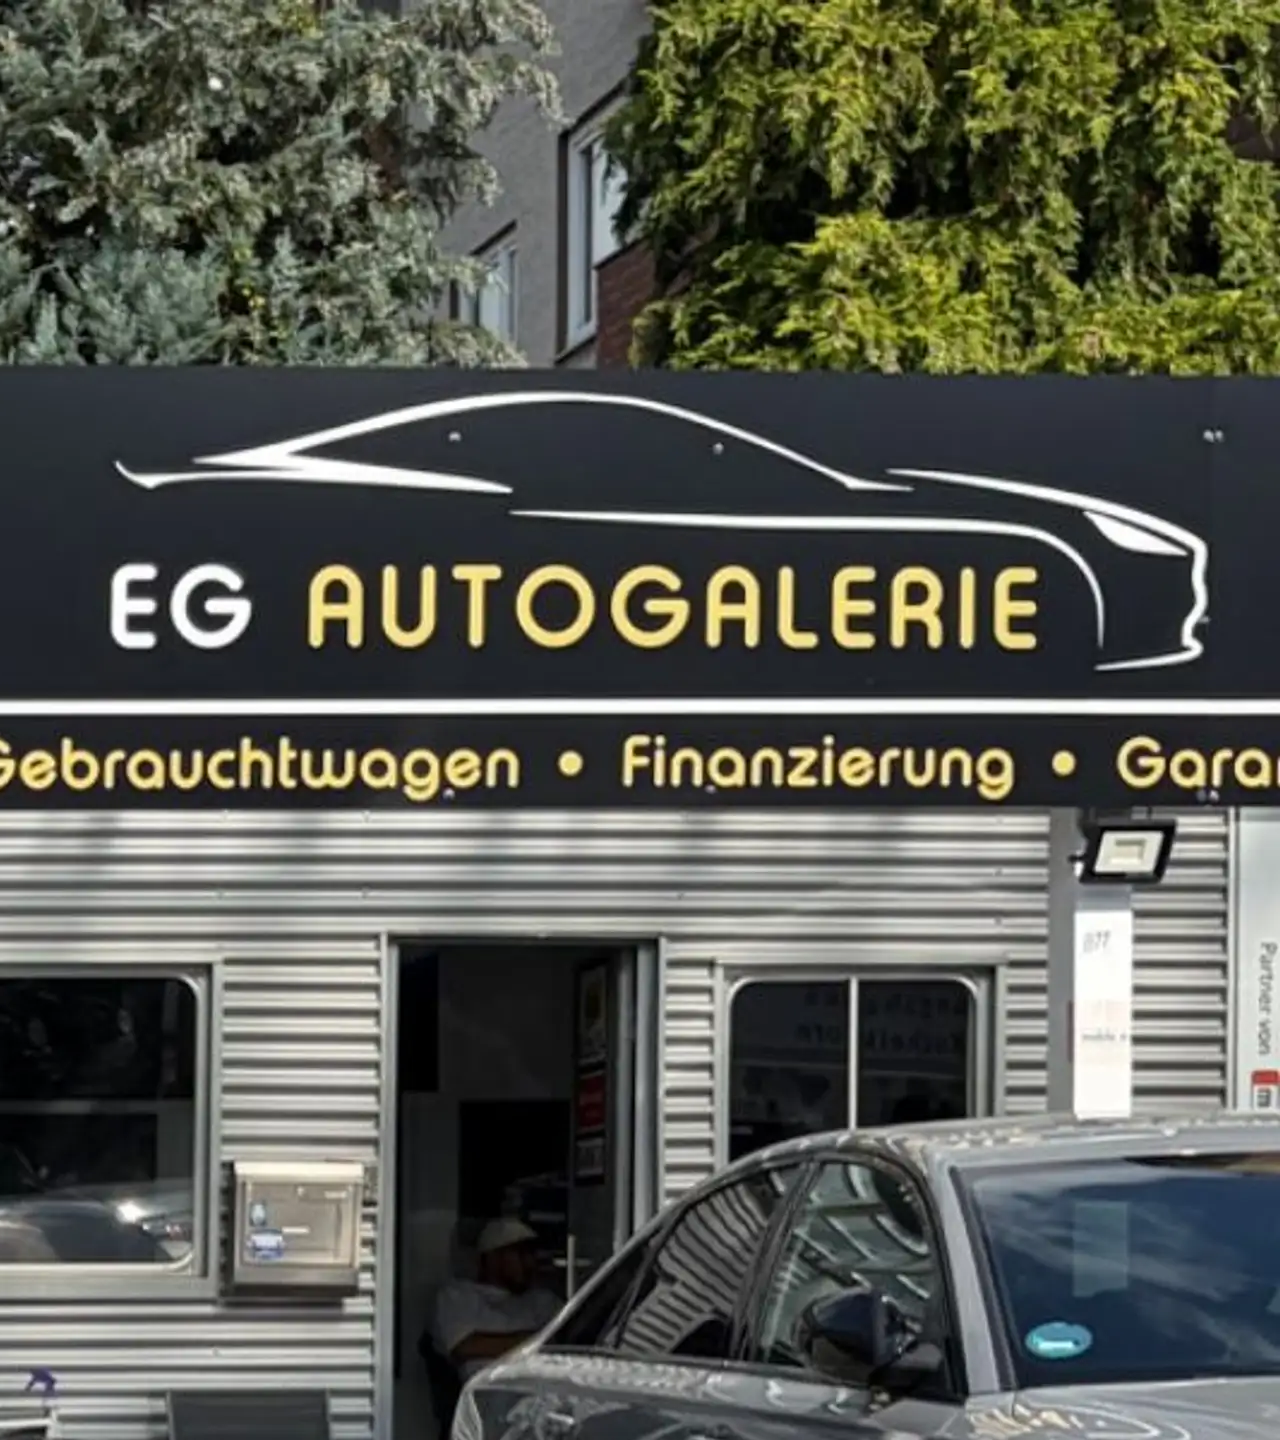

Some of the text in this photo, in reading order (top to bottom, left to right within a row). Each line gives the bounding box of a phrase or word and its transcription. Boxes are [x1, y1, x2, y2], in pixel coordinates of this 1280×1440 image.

[110, 563, 1038, 650] EG AUTOGALERIE
[622, 734, 1015, 801] Finanzierung
[1116, 735, 1280, 788] Gara
[1257, 942, 1278, 1056] Partner von
